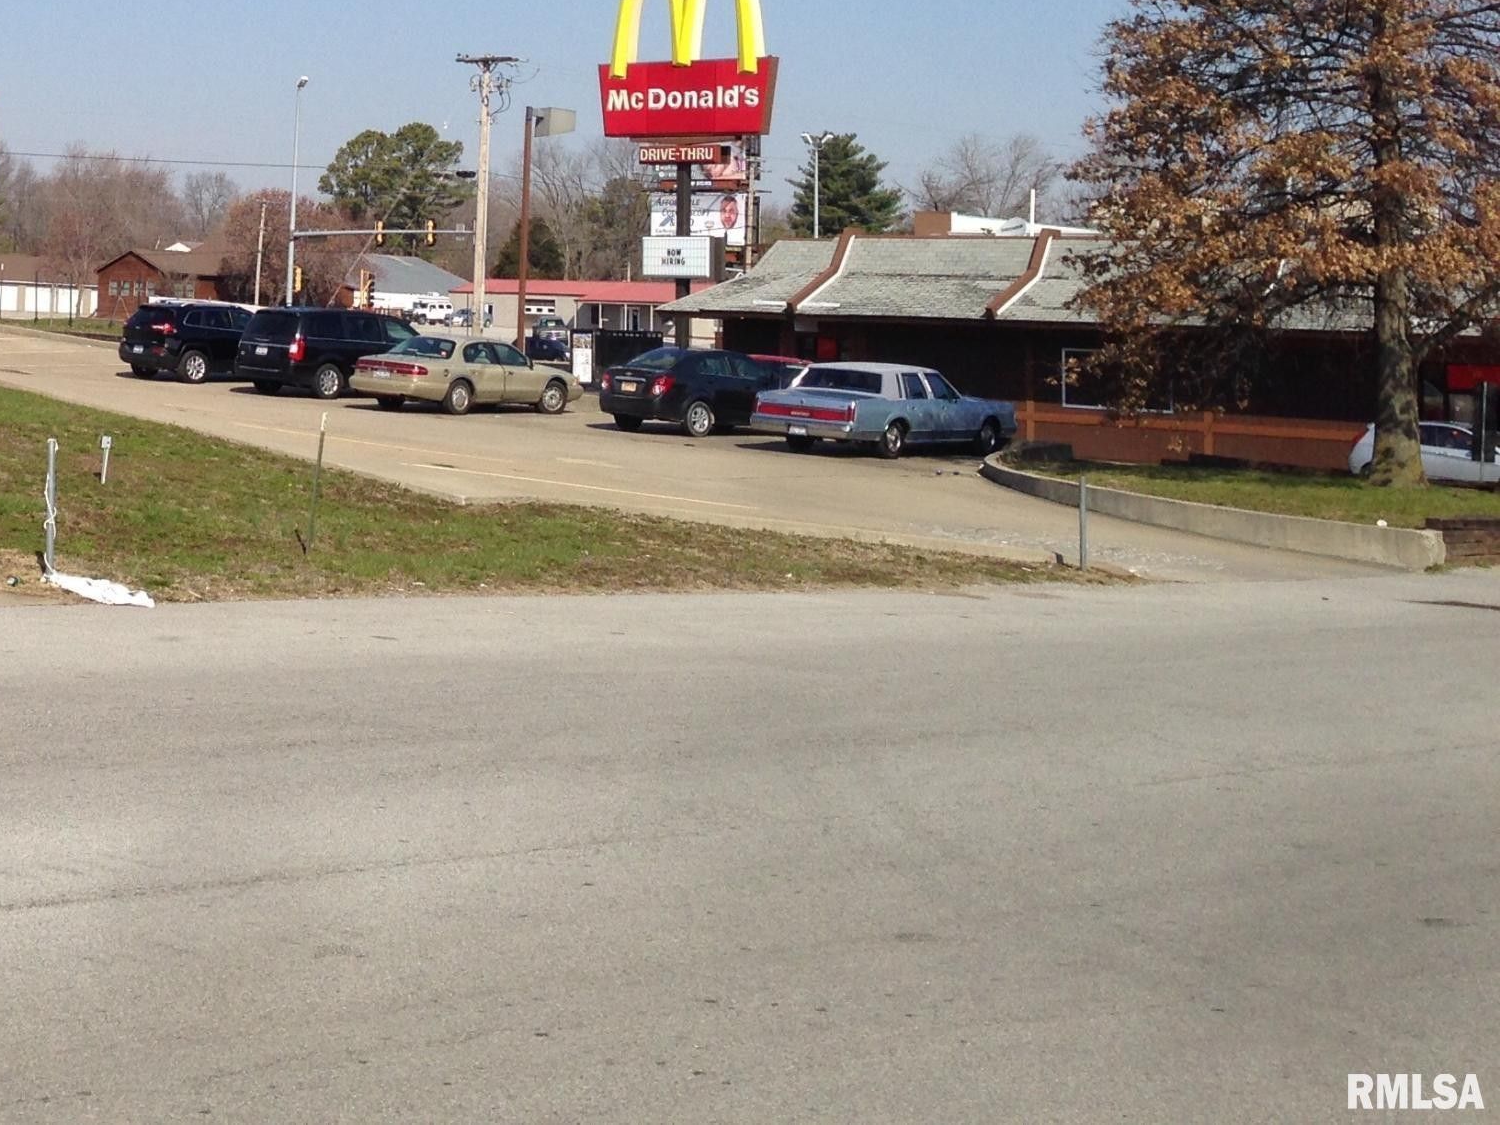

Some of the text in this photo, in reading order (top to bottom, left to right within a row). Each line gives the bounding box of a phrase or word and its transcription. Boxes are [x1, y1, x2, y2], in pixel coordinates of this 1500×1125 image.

[606, 84, 760, 111] McDonald's
[640, 147, 714, 161] DRIVE-THRU
[661, 257, 685, 266] HIRING
